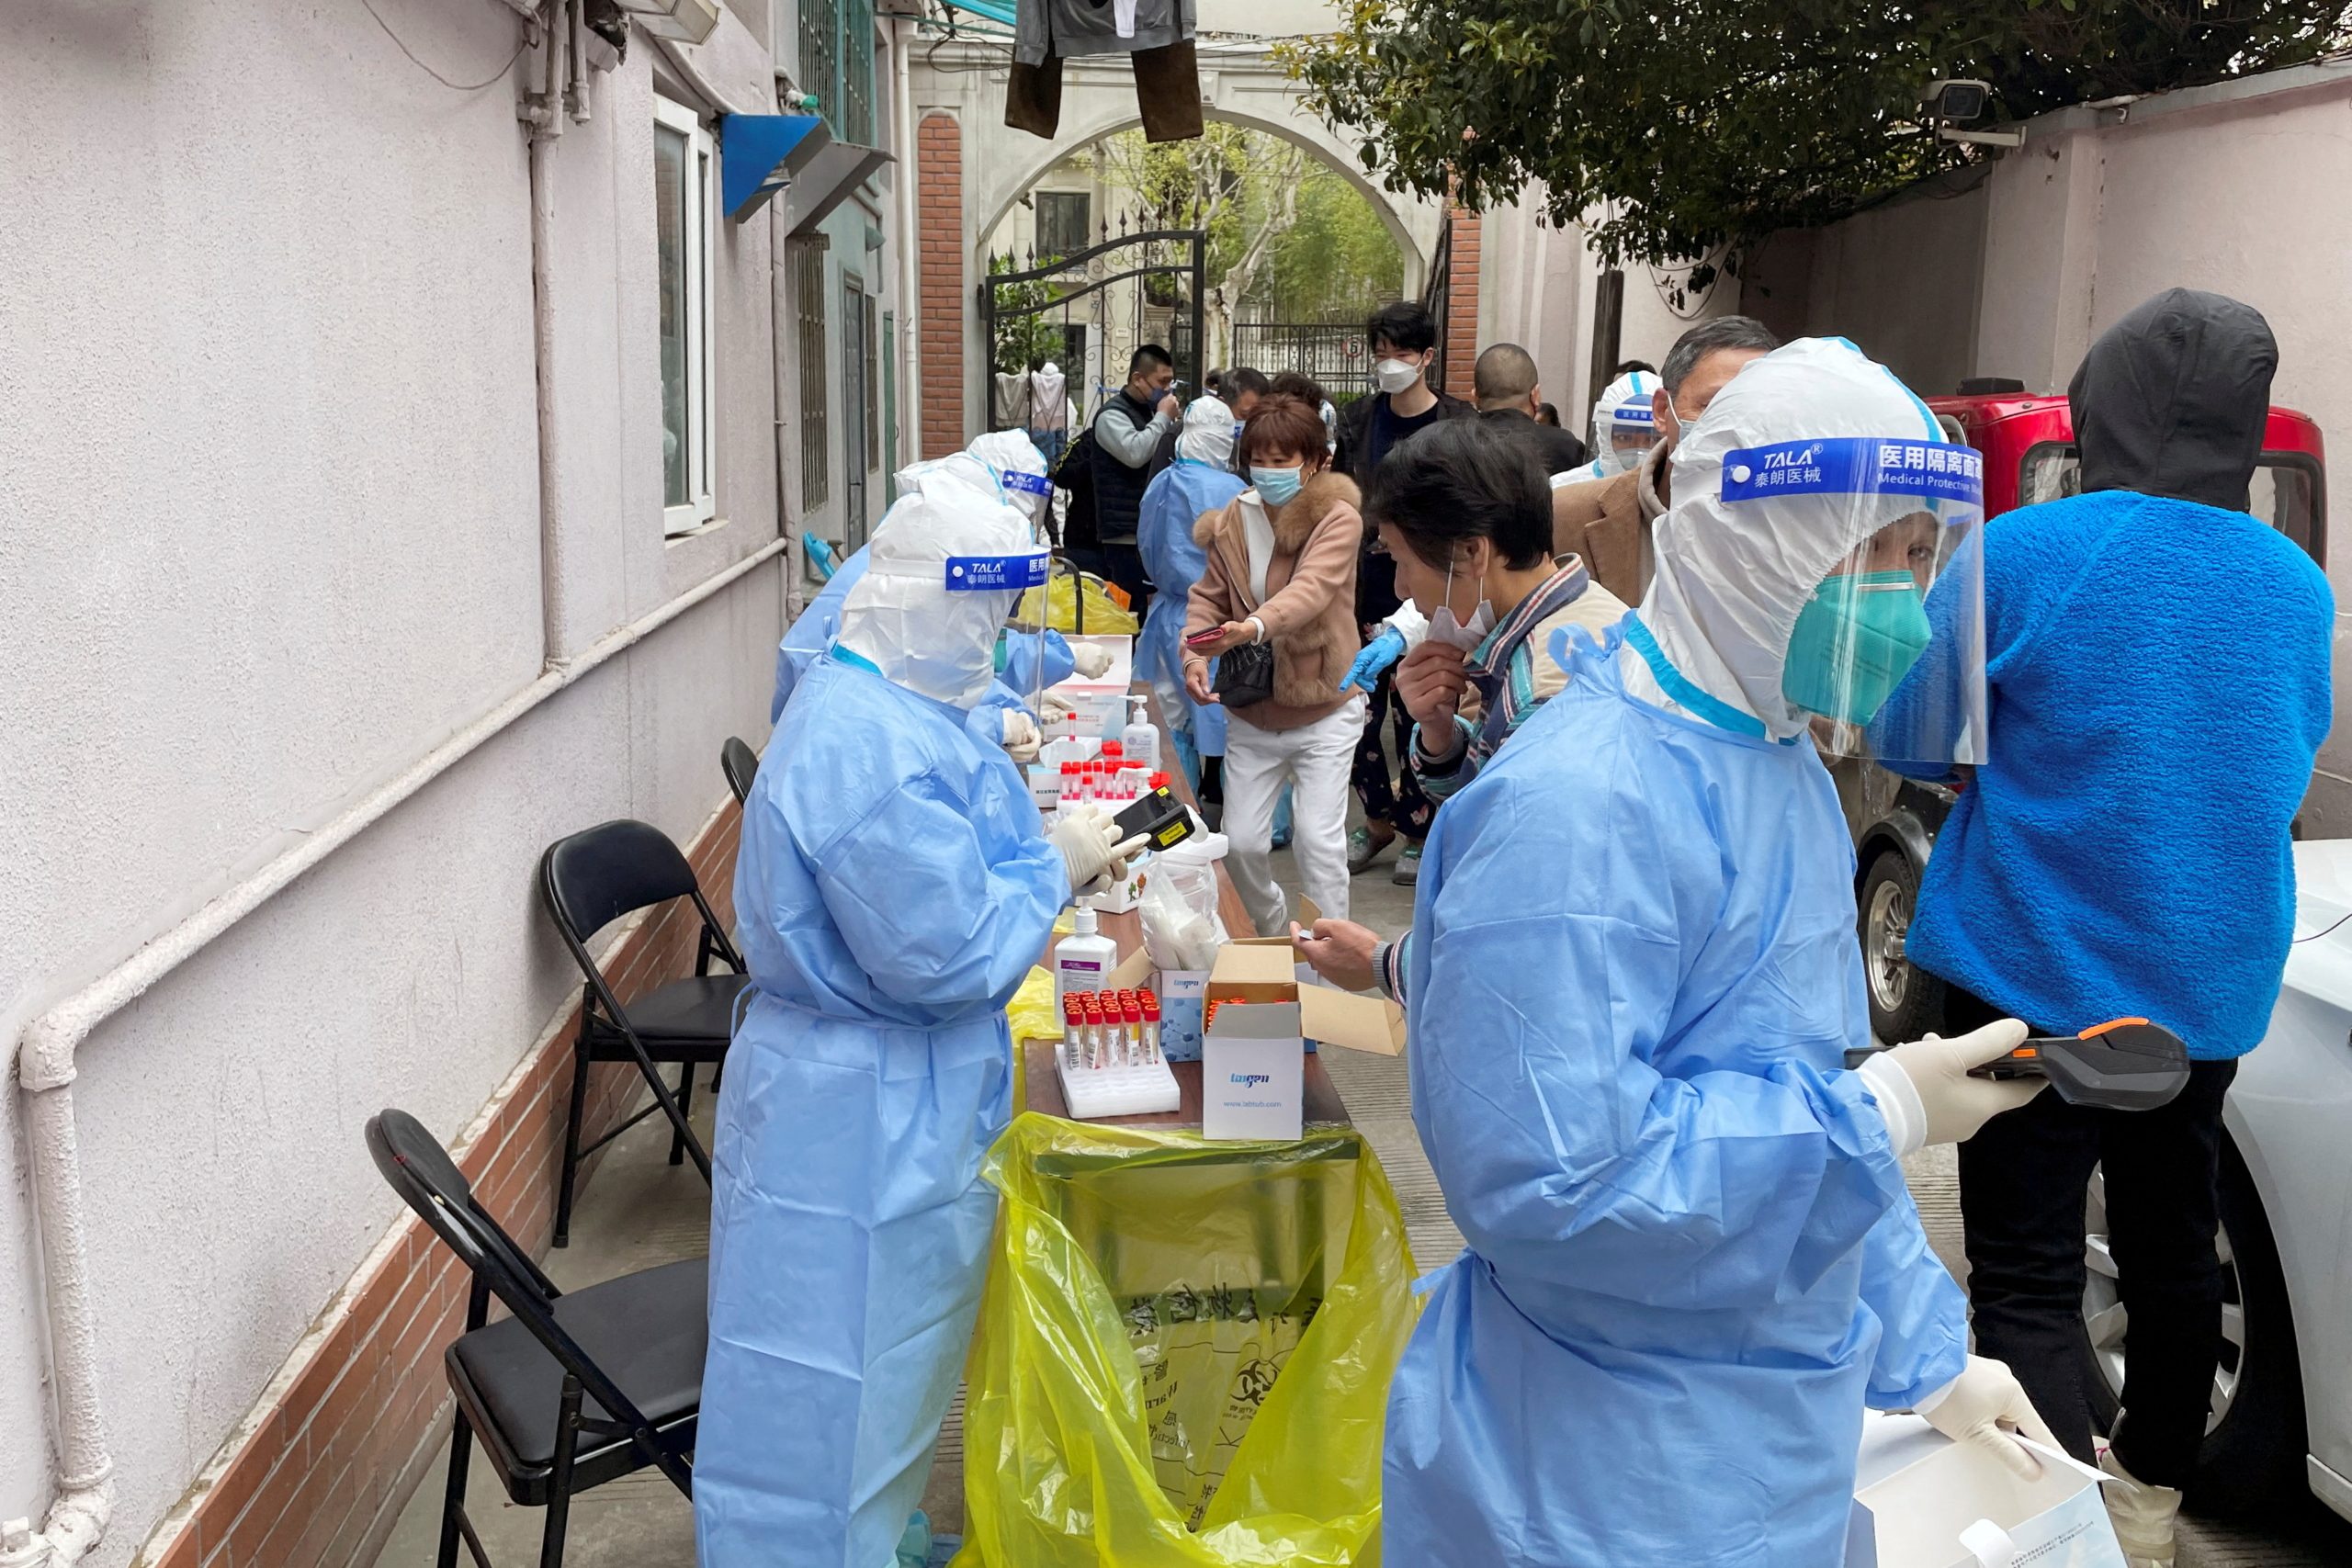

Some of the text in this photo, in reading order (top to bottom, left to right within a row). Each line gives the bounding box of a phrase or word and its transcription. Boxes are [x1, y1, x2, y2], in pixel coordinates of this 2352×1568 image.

[1755, 467, 1822, 488] 泰朗医械
[1878, 472, 1924, 486] Medical
